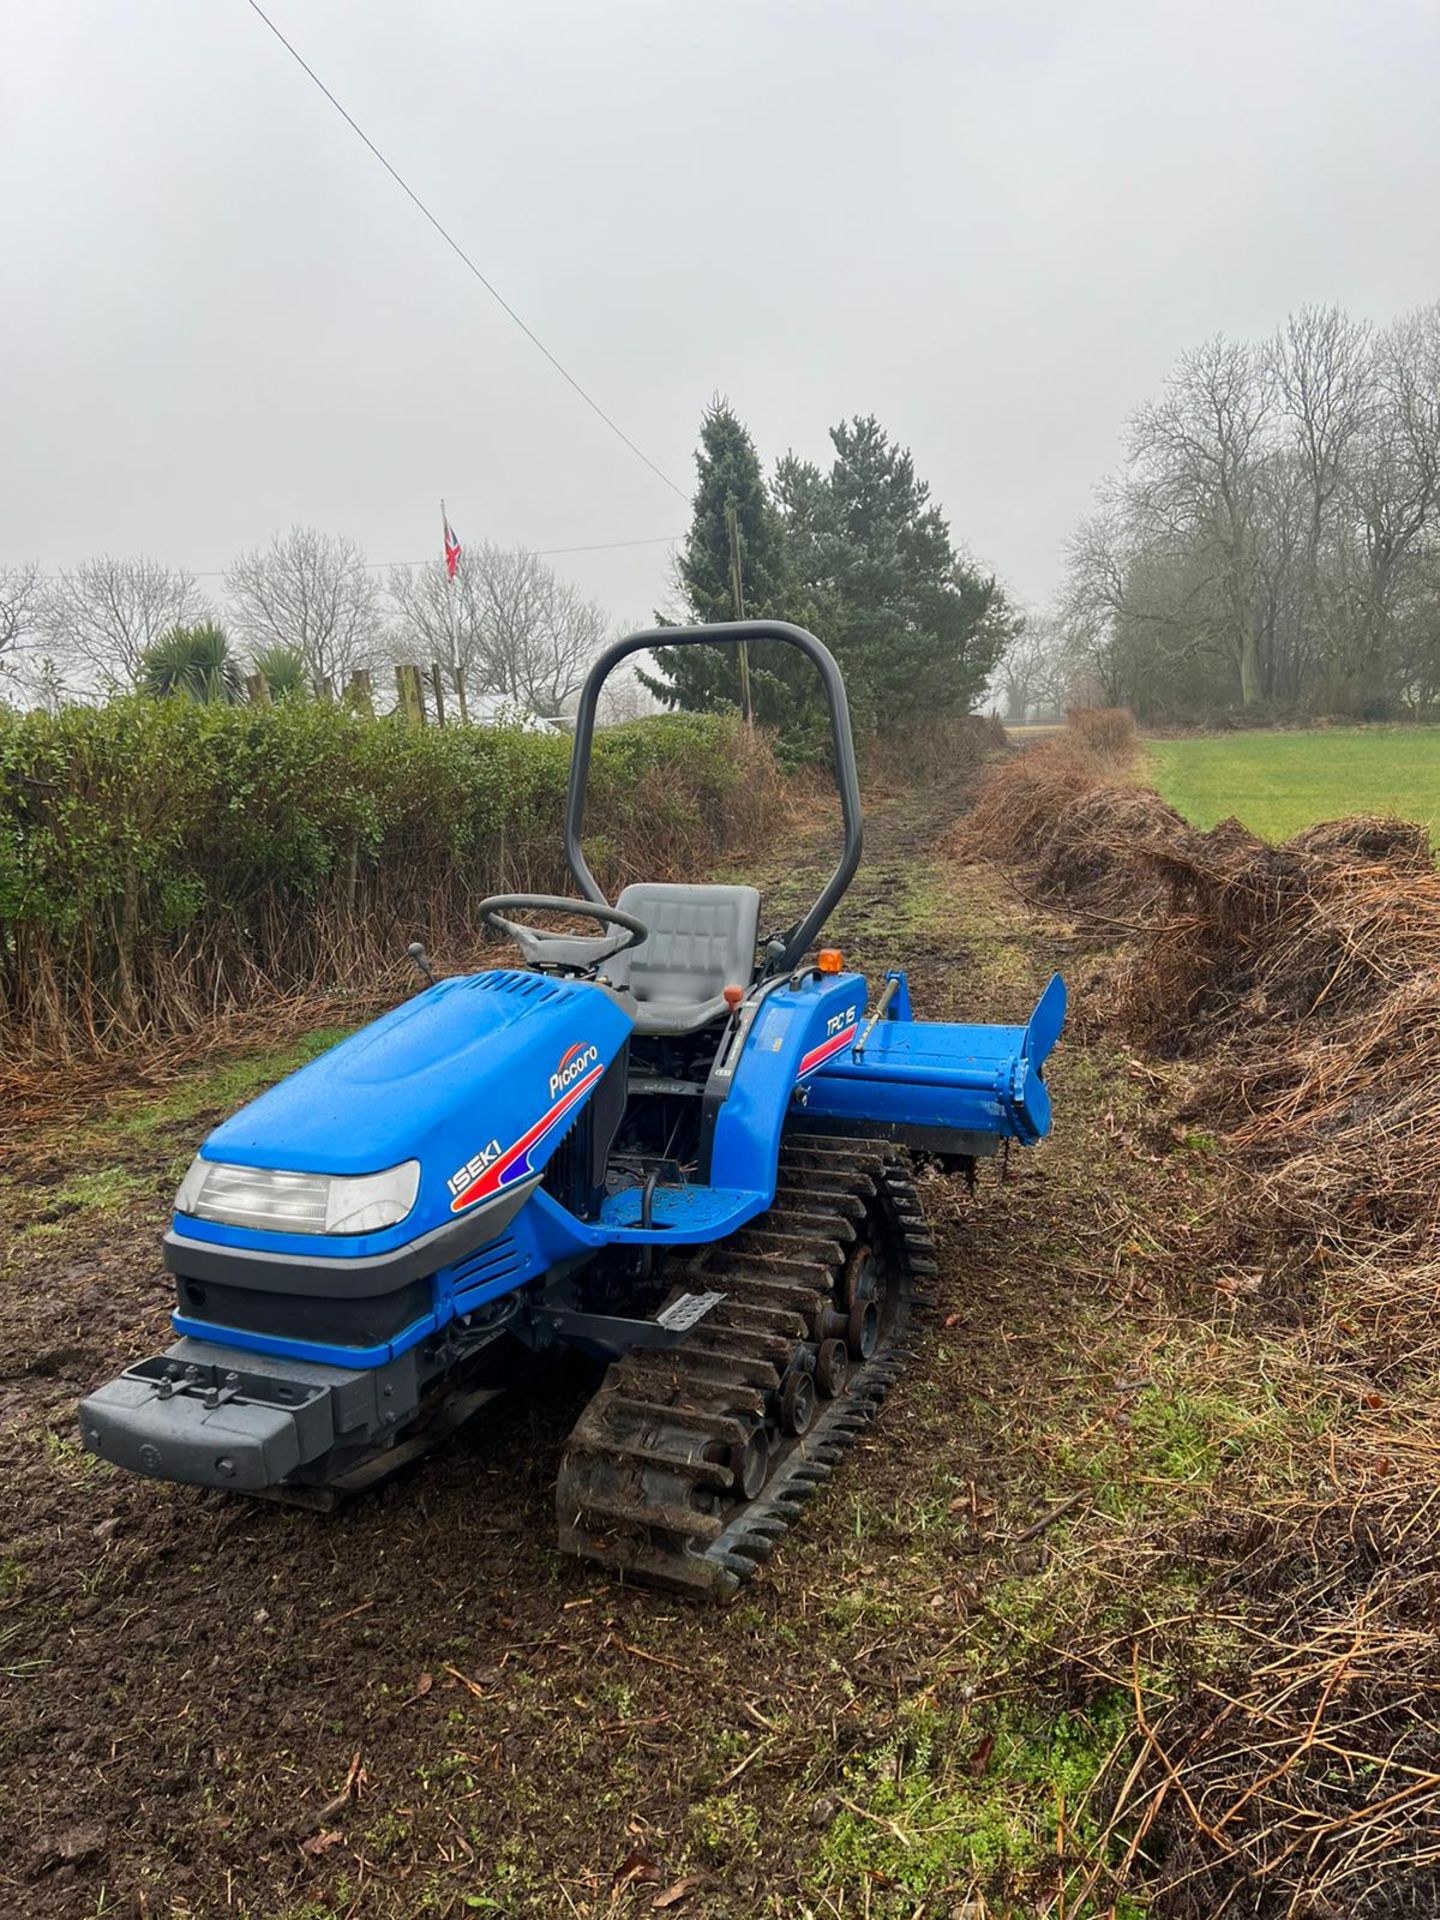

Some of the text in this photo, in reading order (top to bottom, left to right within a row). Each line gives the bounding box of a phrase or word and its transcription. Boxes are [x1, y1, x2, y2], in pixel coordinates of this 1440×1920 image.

[827, 1012, 845, 1036] TPC
[549, 1045, 598, 1099] Piccoro
[446, 1139, 502, 1195] ISEKI
